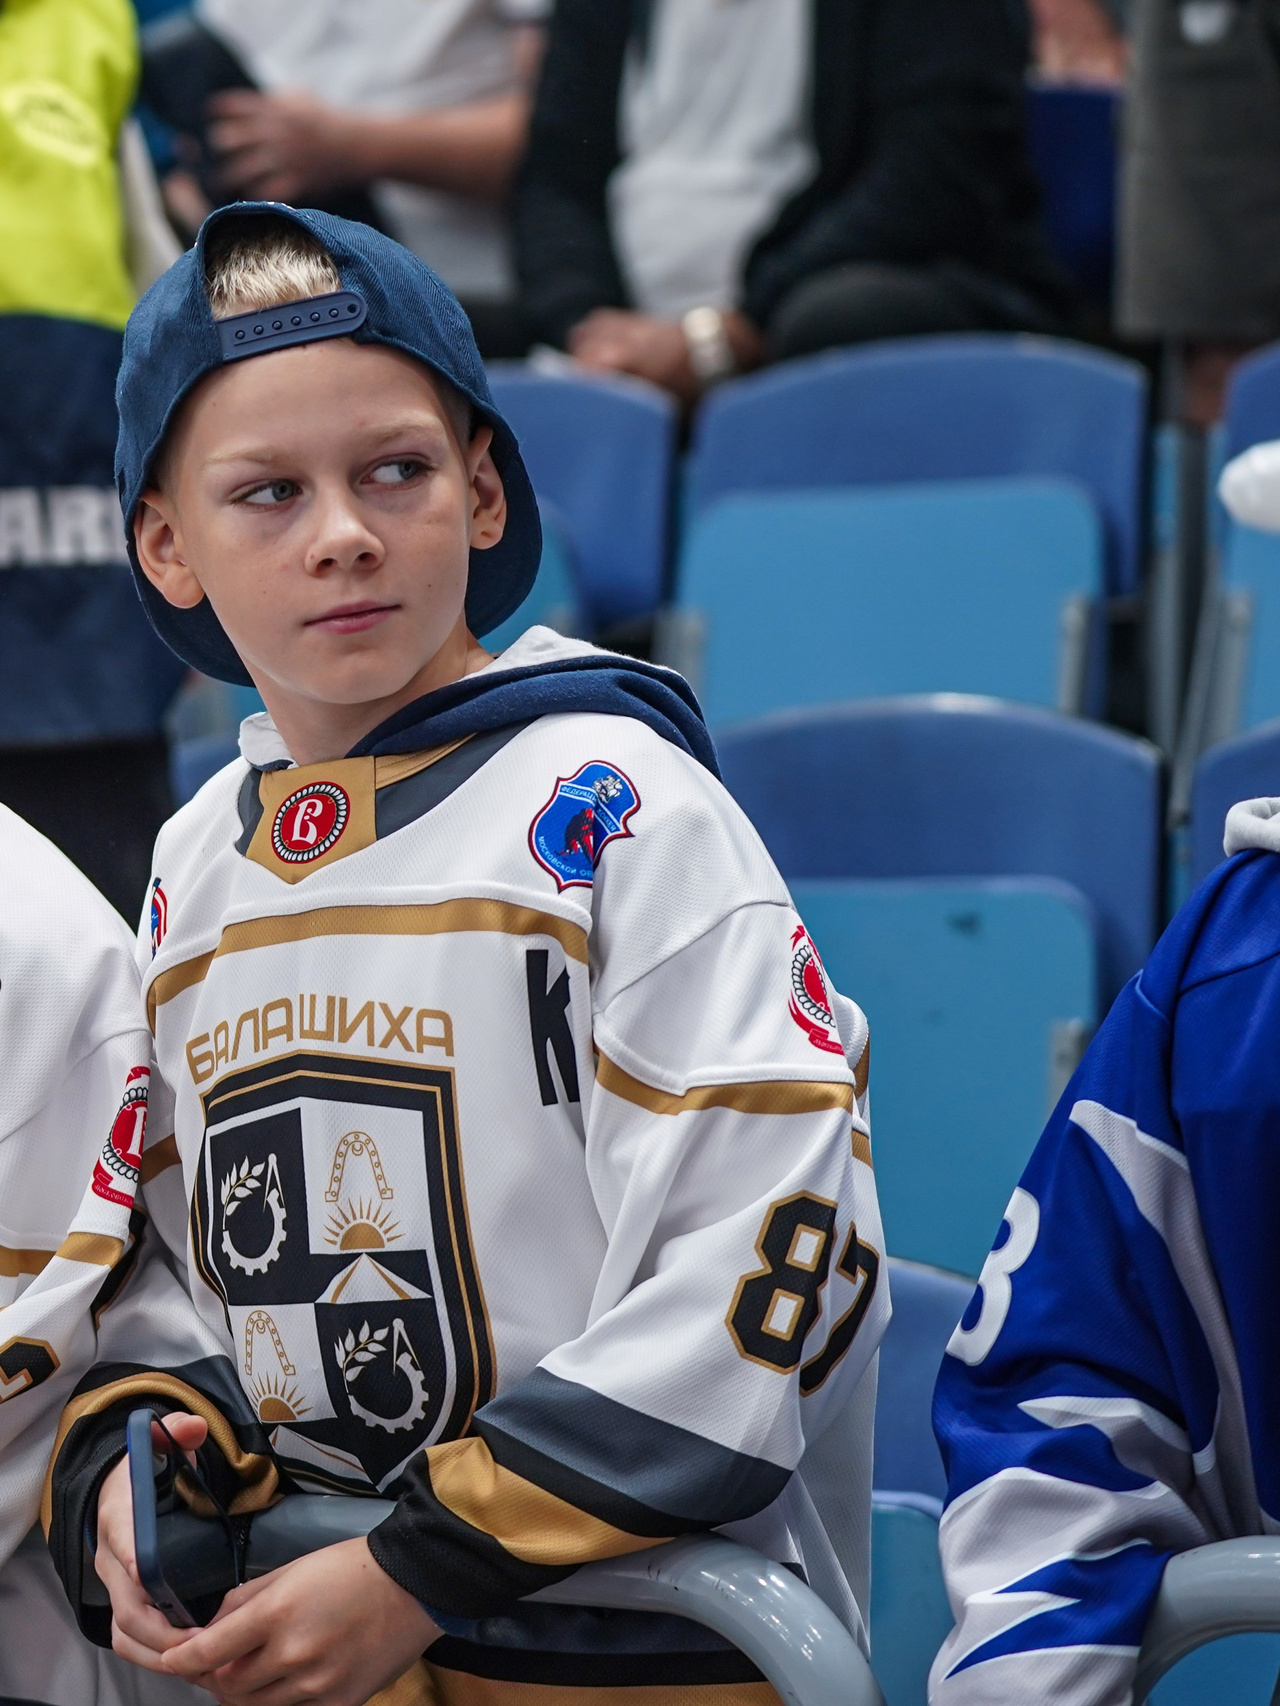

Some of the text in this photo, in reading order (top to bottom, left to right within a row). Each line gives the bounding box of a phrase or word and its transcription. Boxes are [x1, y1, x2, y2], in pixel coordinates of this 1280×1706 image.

[537, 834, 577, 875] МОСКОВСКОЙ
[186, 993, 455, 1085] БАЛАШИХА
[724, 1189, 880, 1398] 87
